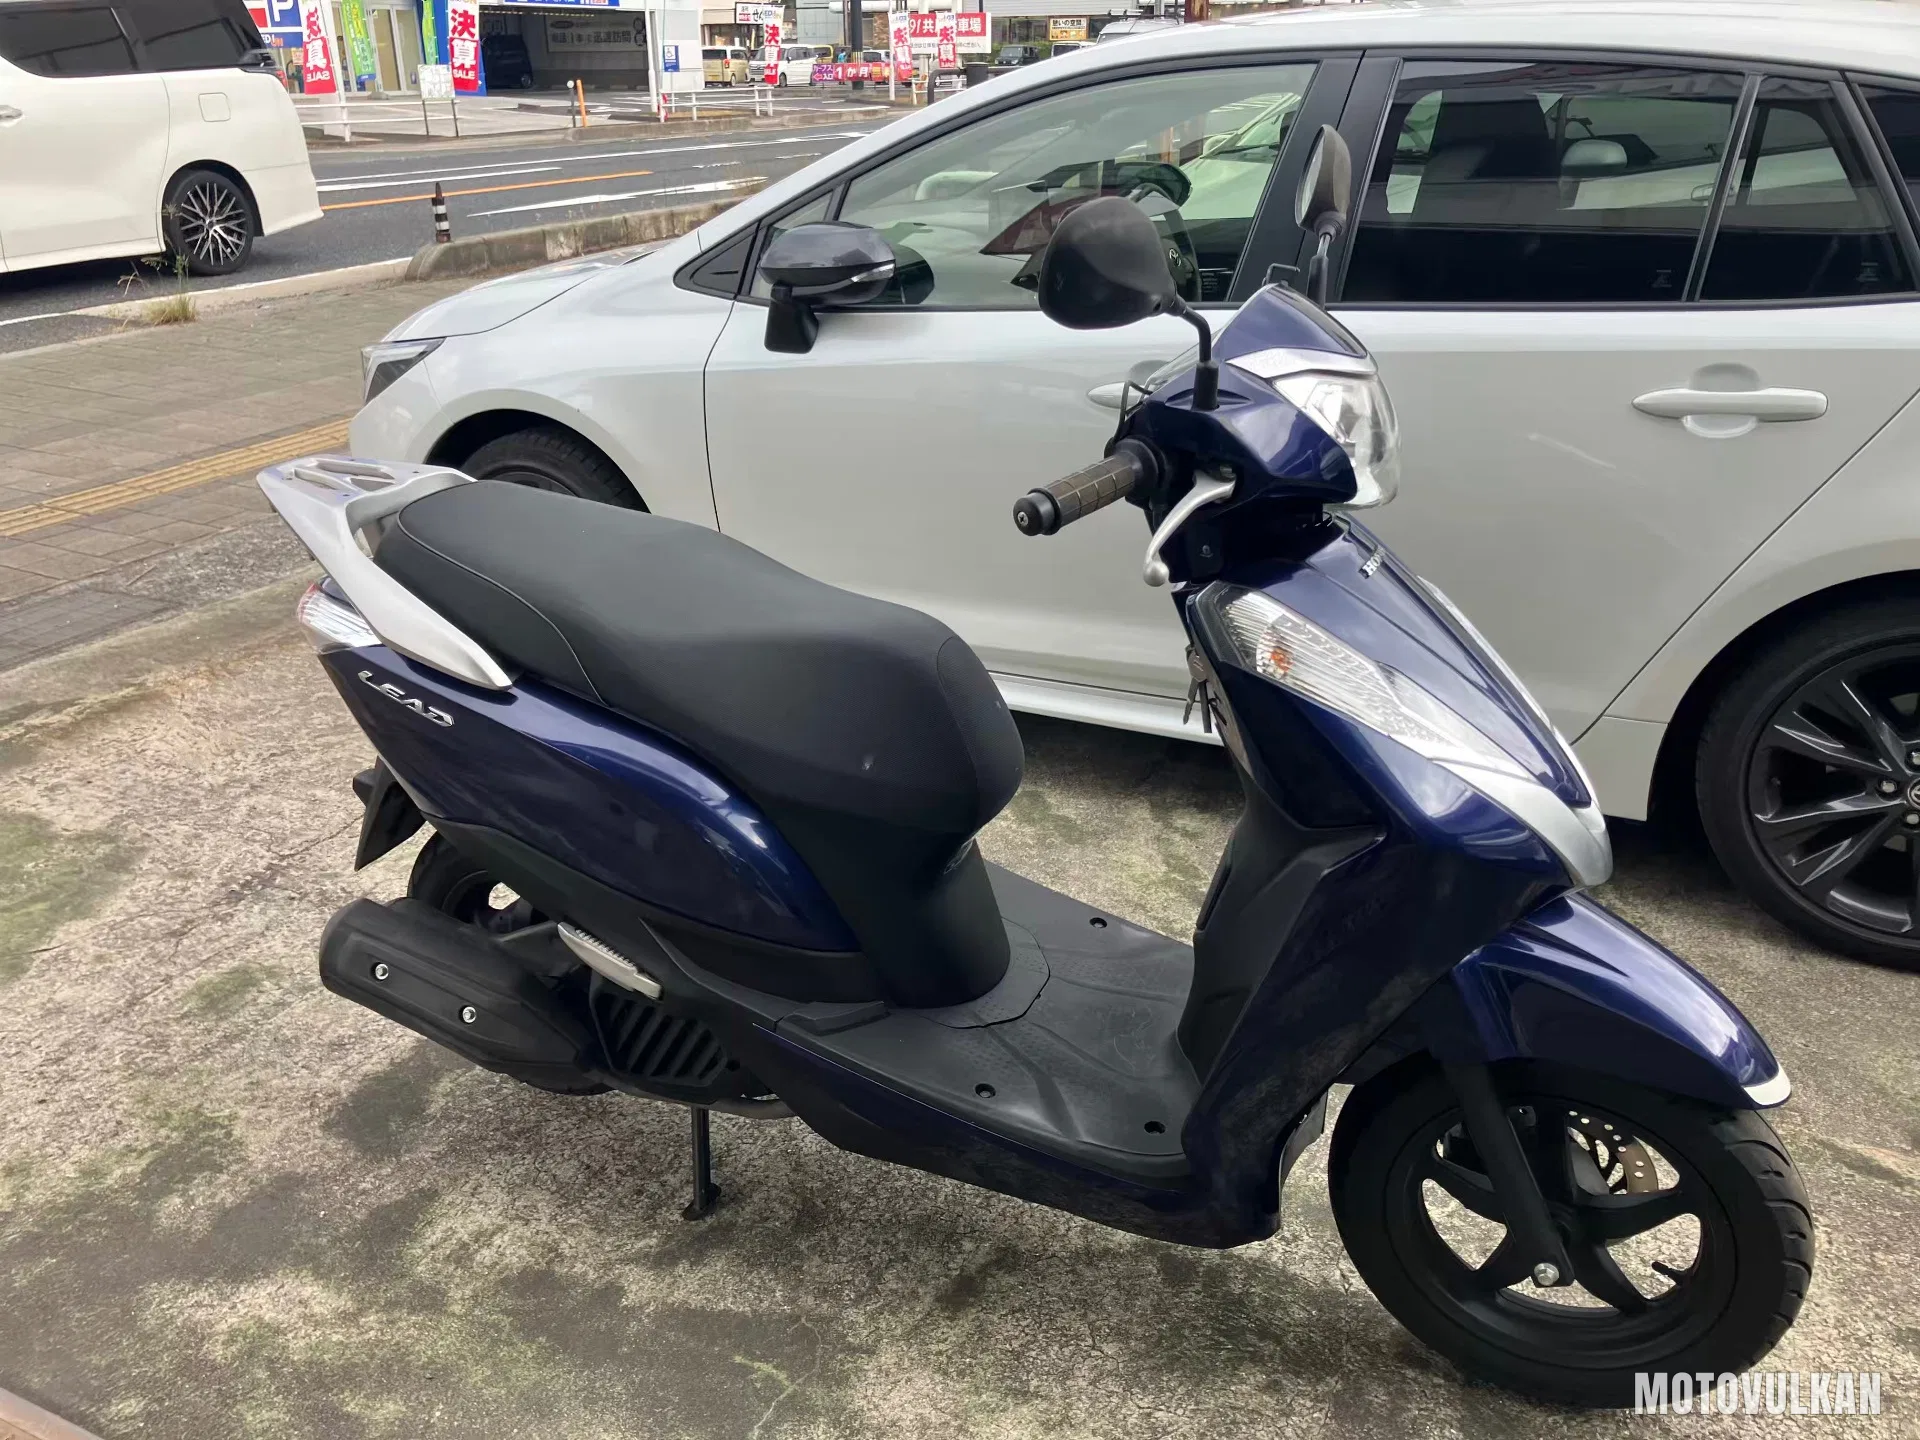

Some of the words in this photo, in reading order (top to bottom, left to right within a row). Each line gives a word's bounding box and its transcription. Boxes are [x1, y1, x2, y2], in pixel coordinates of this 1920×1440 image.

[450, 8, 477, 69] 決算
[452, 69, 476, 80] SALE
[358, 670, 454, 727] LEAD
